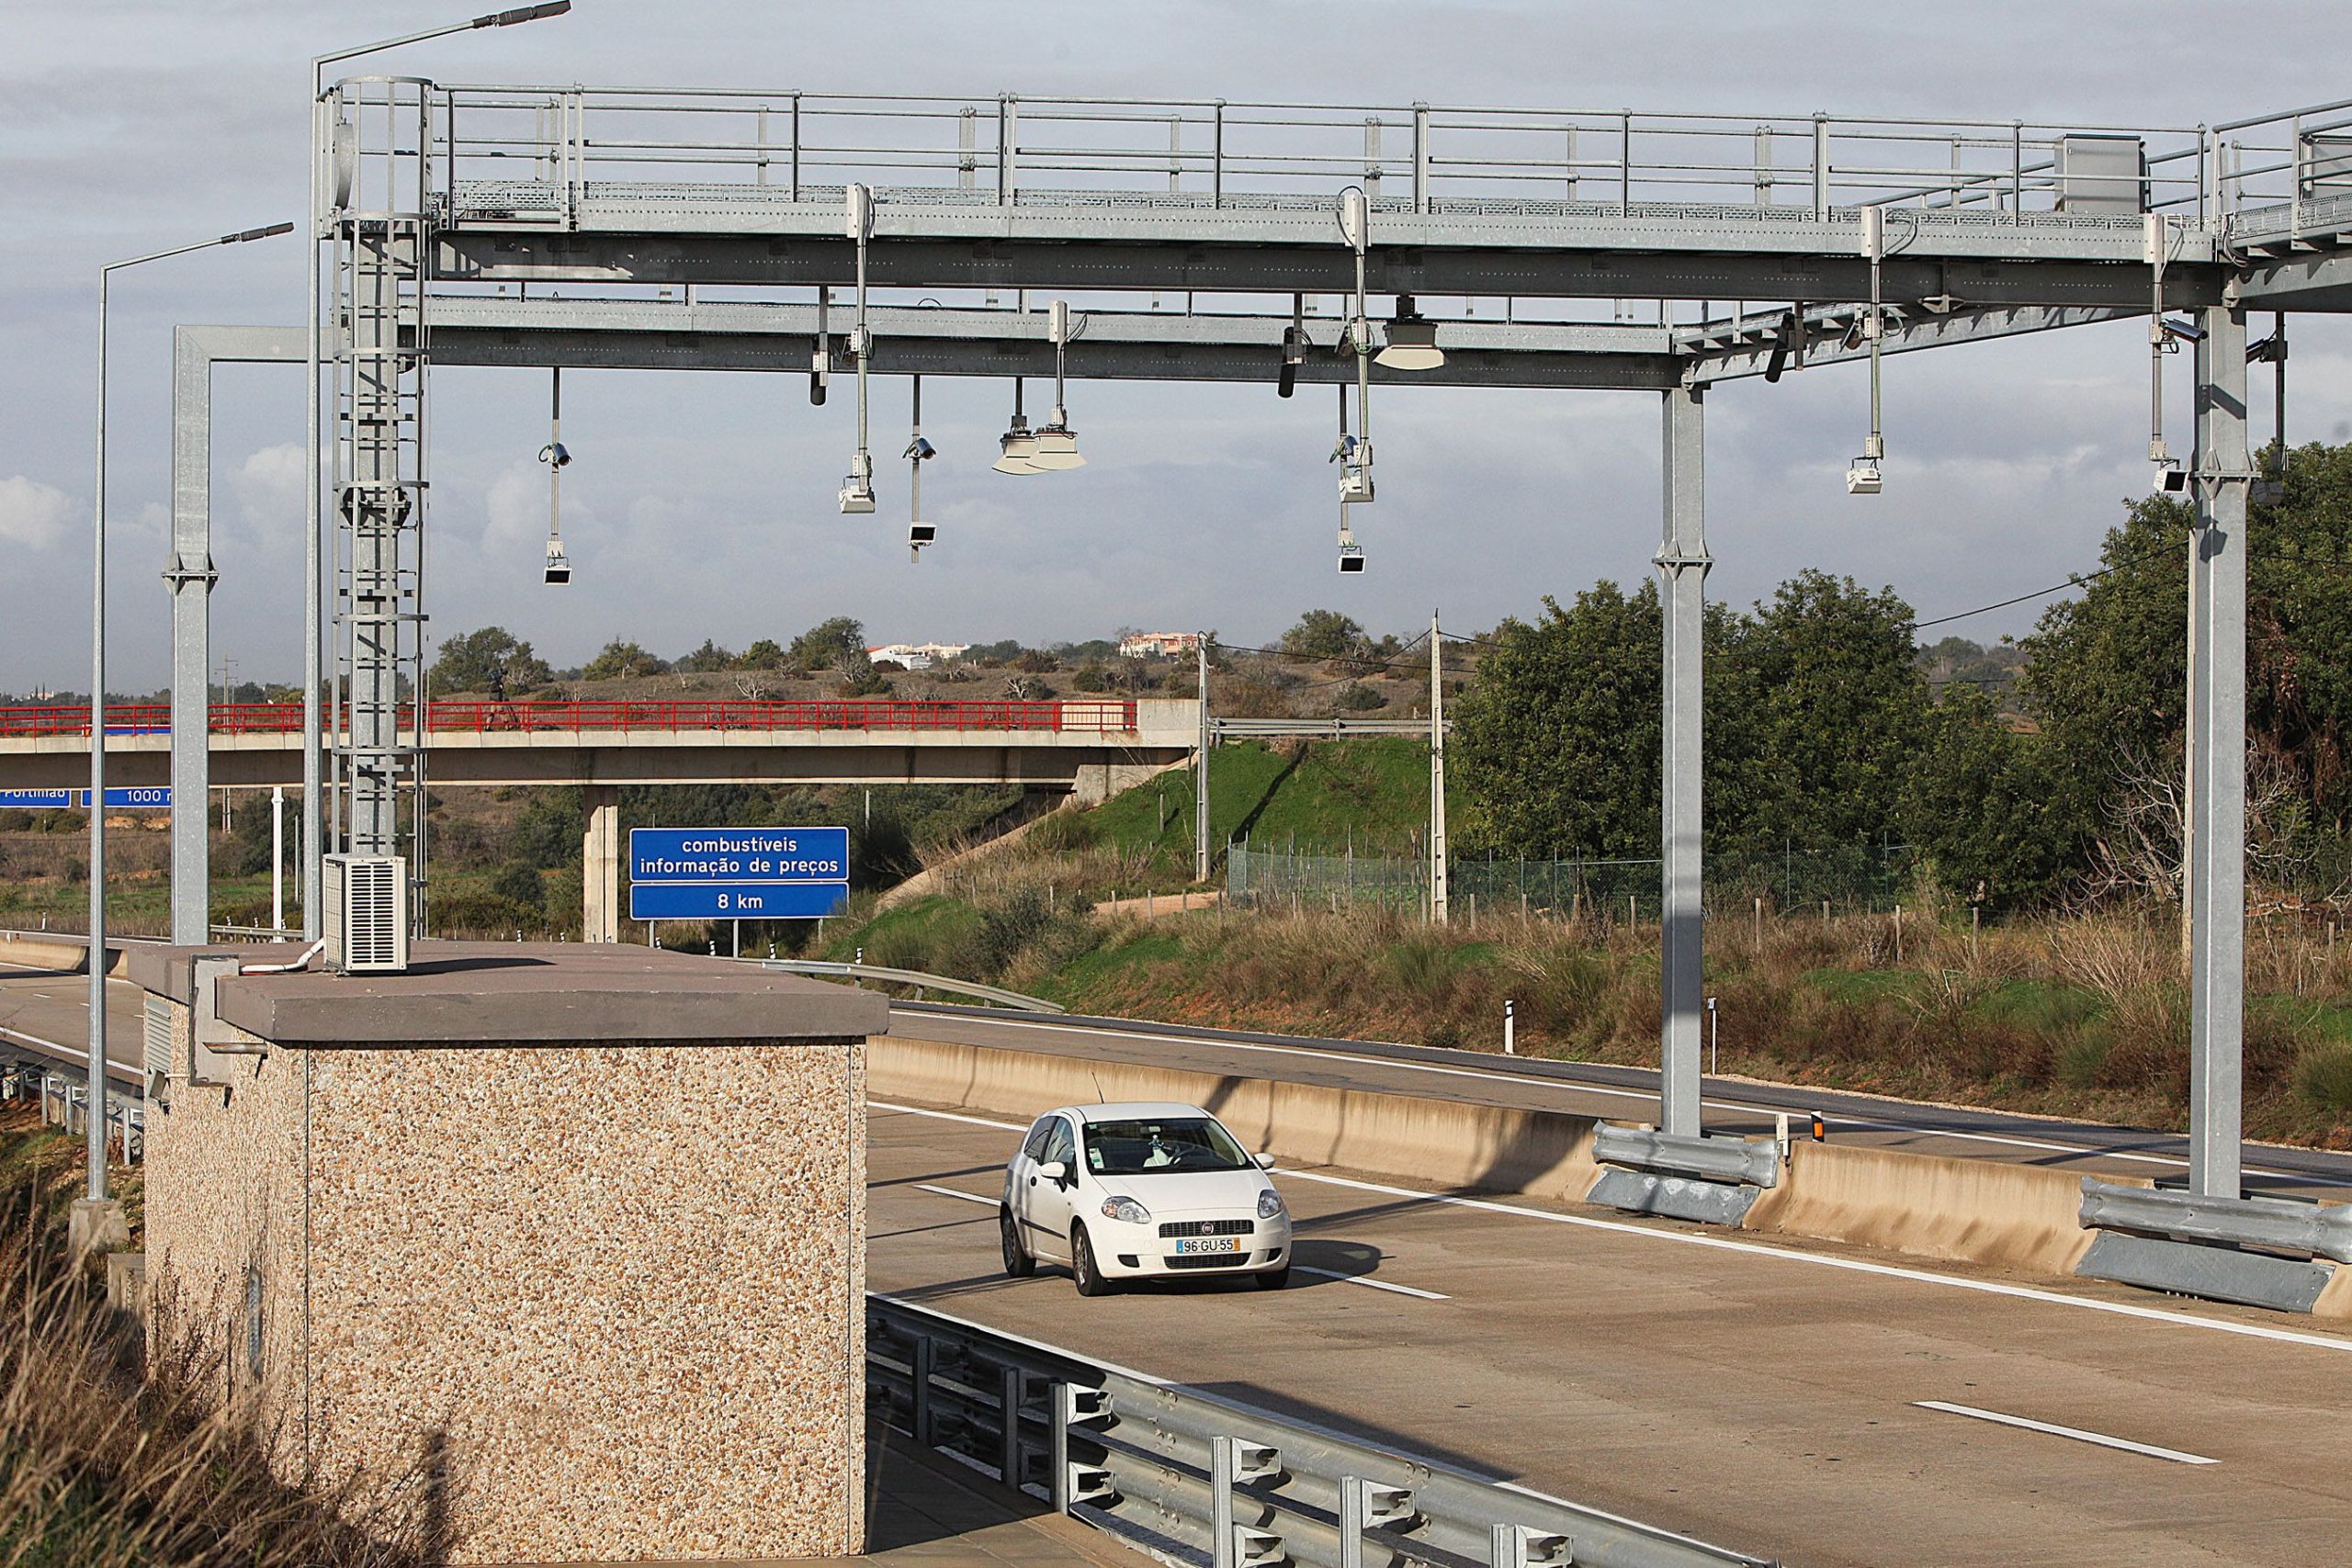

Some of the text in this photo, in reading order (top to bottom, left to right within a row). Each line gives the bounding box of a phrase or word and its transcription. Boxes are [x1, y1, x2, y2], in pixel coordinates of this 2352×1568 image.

[127, 790, 162, 802] 1000
[682, 836, 798, 853] combustíveis
[640, 857, 839, 877] informação de preços
[717, 893, 763, 909] 8 km
